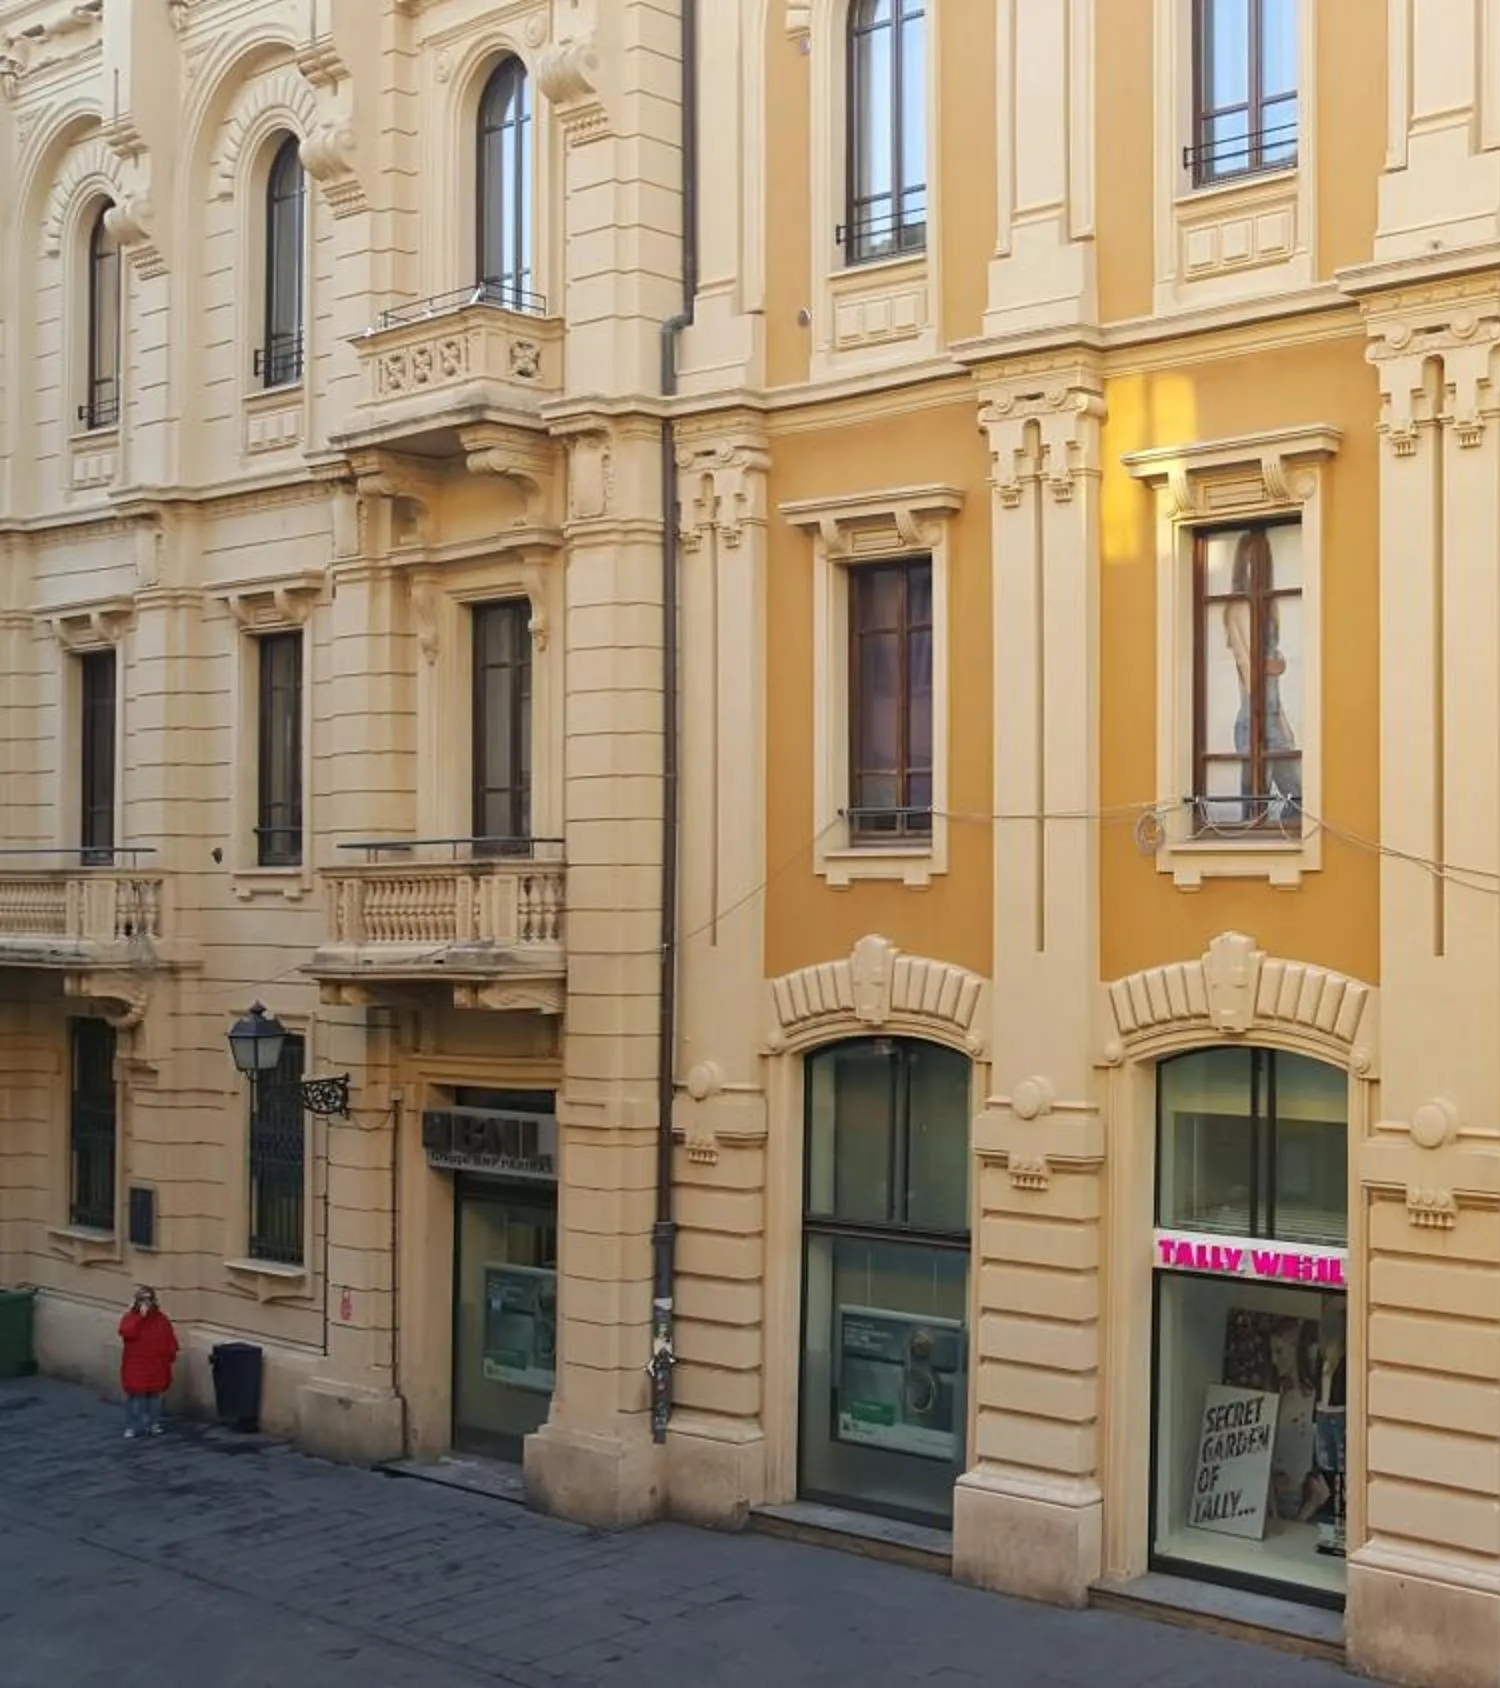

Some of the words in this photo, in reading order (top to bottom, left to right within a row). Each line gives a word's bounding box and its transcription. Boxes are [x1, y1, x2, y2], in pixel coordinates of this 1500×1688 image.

[1158, 1238, 1243, 1272] TALLY
[1205, 1396, 1265, 1434] SECRET
[1201, 1423, 1271, 1464] GARDEN
[1197, 1465, 1221, 1494] OF
